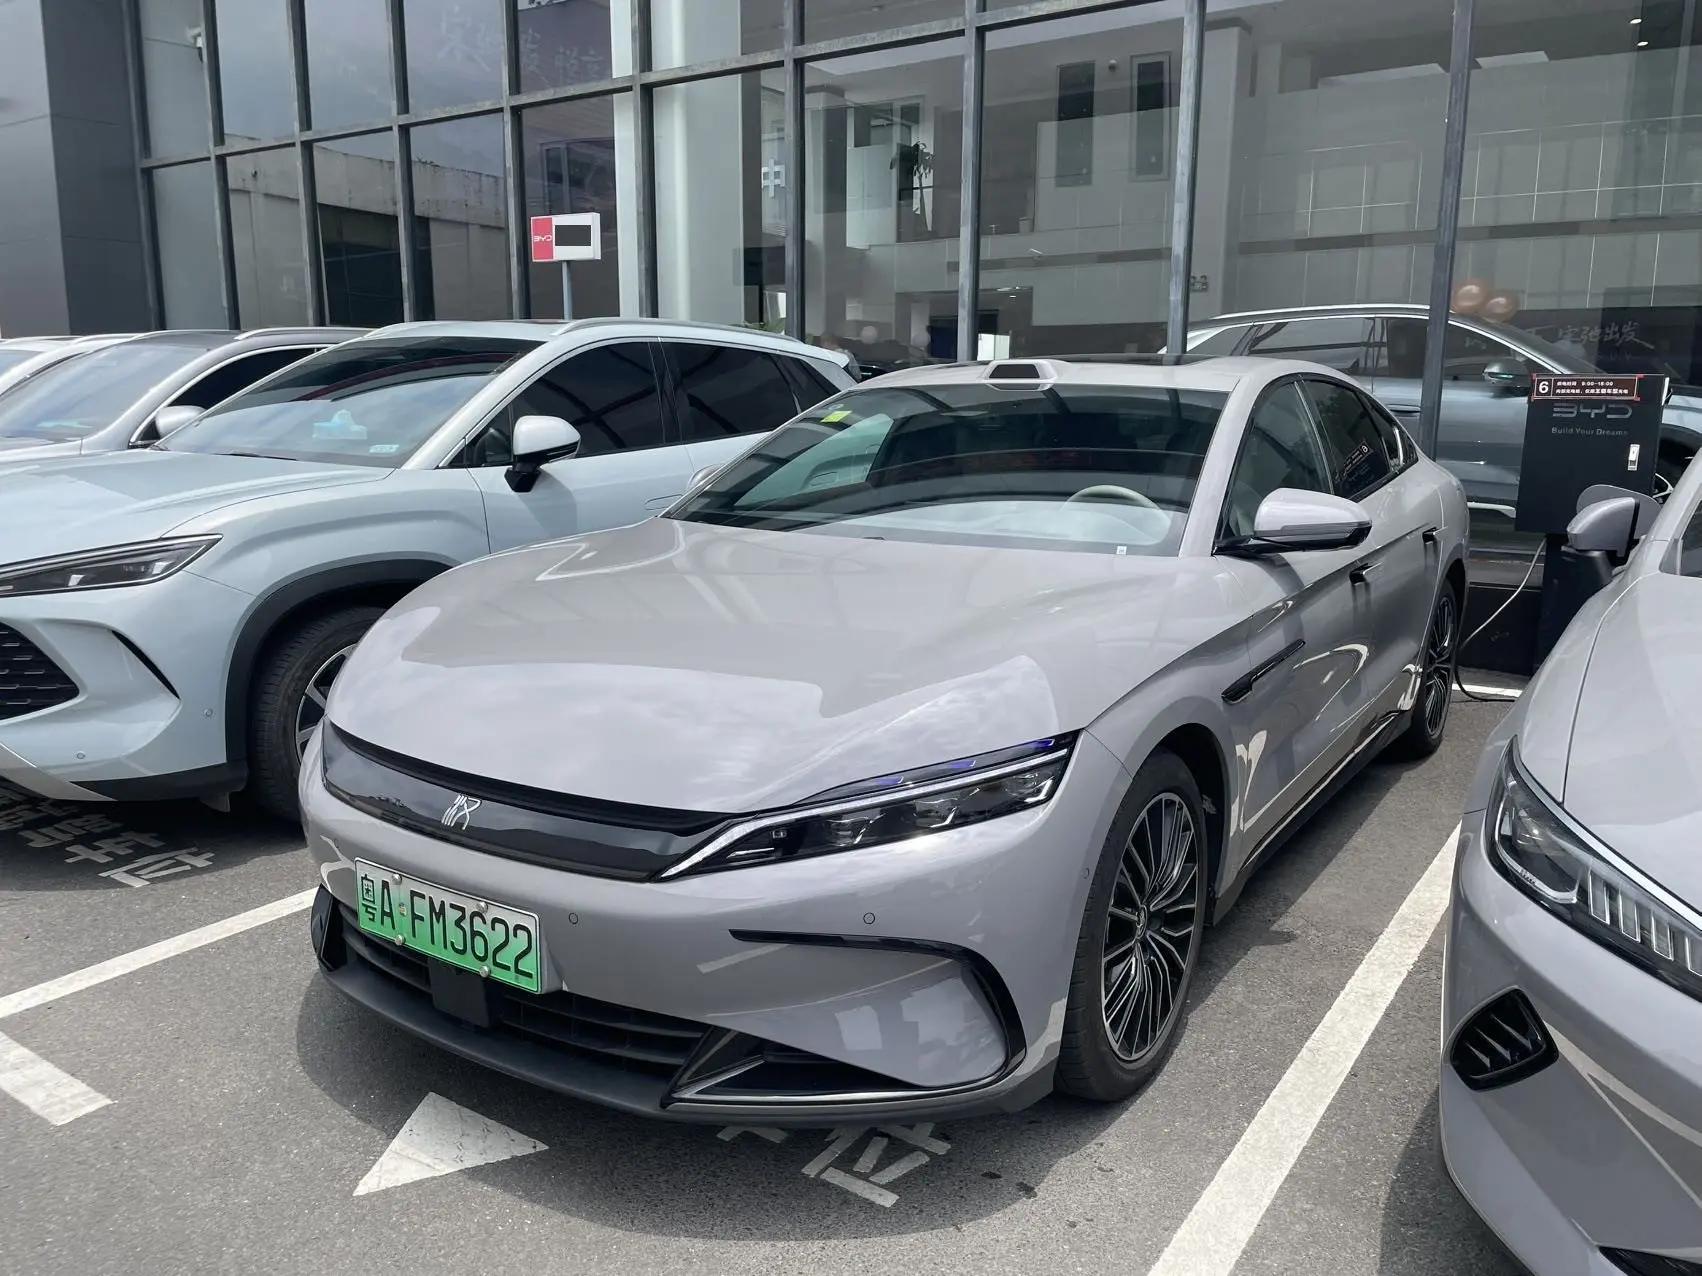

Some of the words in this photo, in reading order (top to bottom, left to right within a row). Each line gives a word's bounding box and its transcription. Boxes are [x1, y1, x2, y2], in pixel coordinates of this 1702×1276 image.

[533, 234, 553, 242] BYD
[1538, 381, 1549, 394] 6
[1552, 402, 1633, 419] BYD
[1551, 426, 1574, 435] Build
[1575, 427, 1595, 436] Your
[1596, 427, 1629, 436] Dreams
